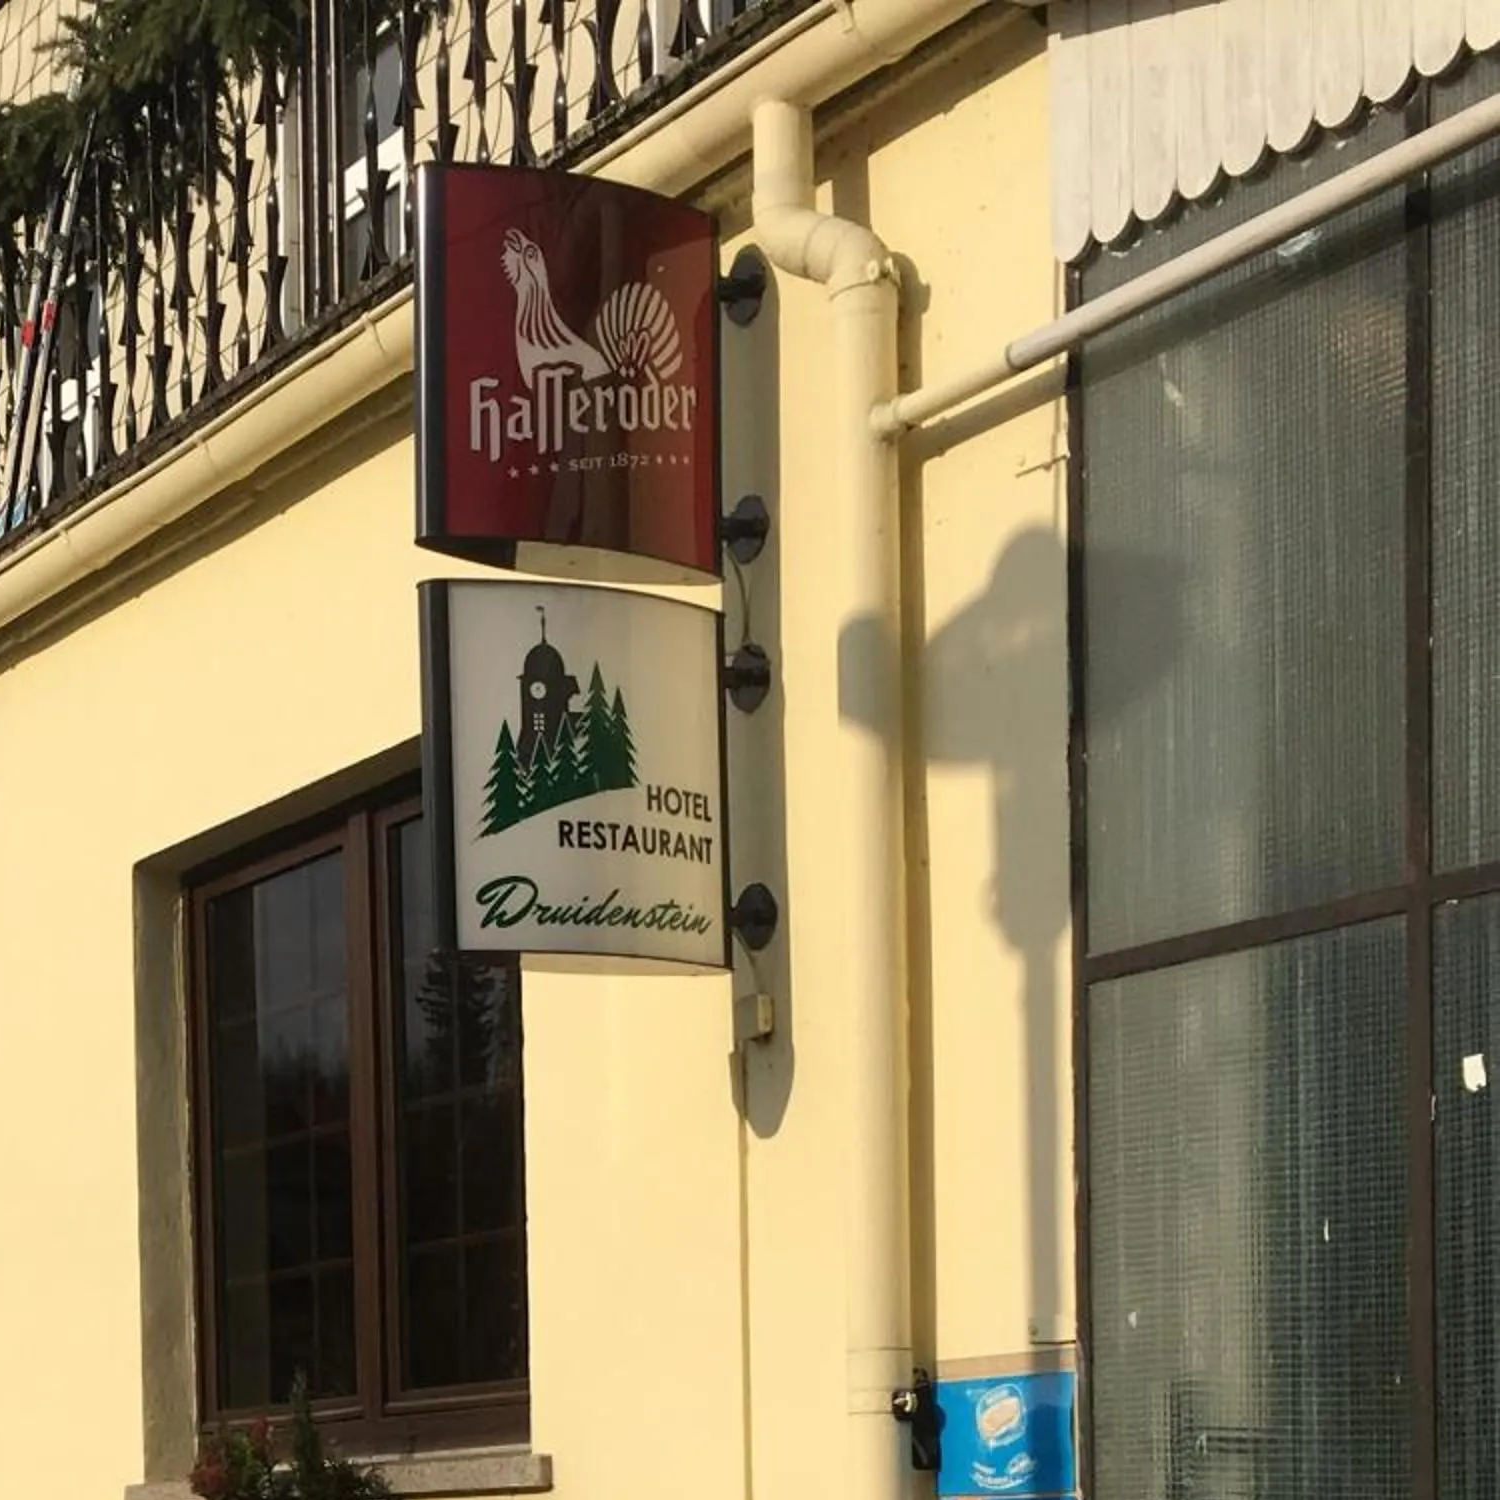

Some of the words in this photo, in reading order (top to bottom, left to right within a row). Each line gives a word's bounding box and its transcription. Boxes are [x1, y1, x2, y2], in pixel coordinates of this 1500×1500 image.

[568, 456, 605, 472] SEIT
[609, 452, 651, 469] 1872
[646, 784, 713, 823] HOTEL
[558, 820, 713, 865] RESTAURANT
[476, 875, 713, 936] Druidenstein
